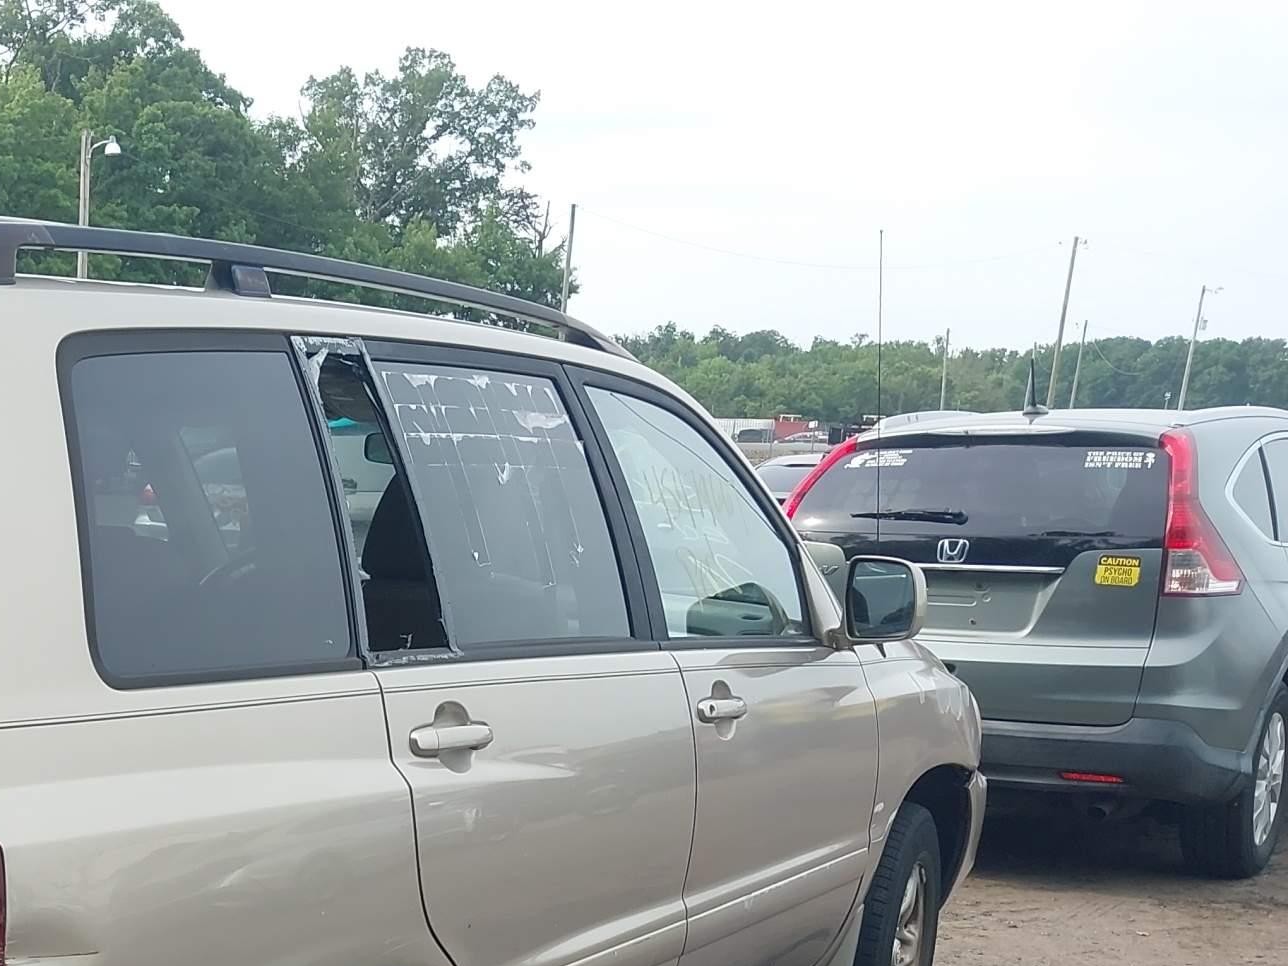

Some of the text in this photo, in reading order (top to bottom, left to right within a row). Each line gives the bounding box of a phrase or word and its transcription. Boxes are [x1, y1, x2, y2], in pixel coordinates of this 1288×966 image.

[1100, 557, 1140, 566] CAUTION
[1103, 567, 1133, 577] PSYCHO
[1100, 576, 1133, 585] ON BOARD
